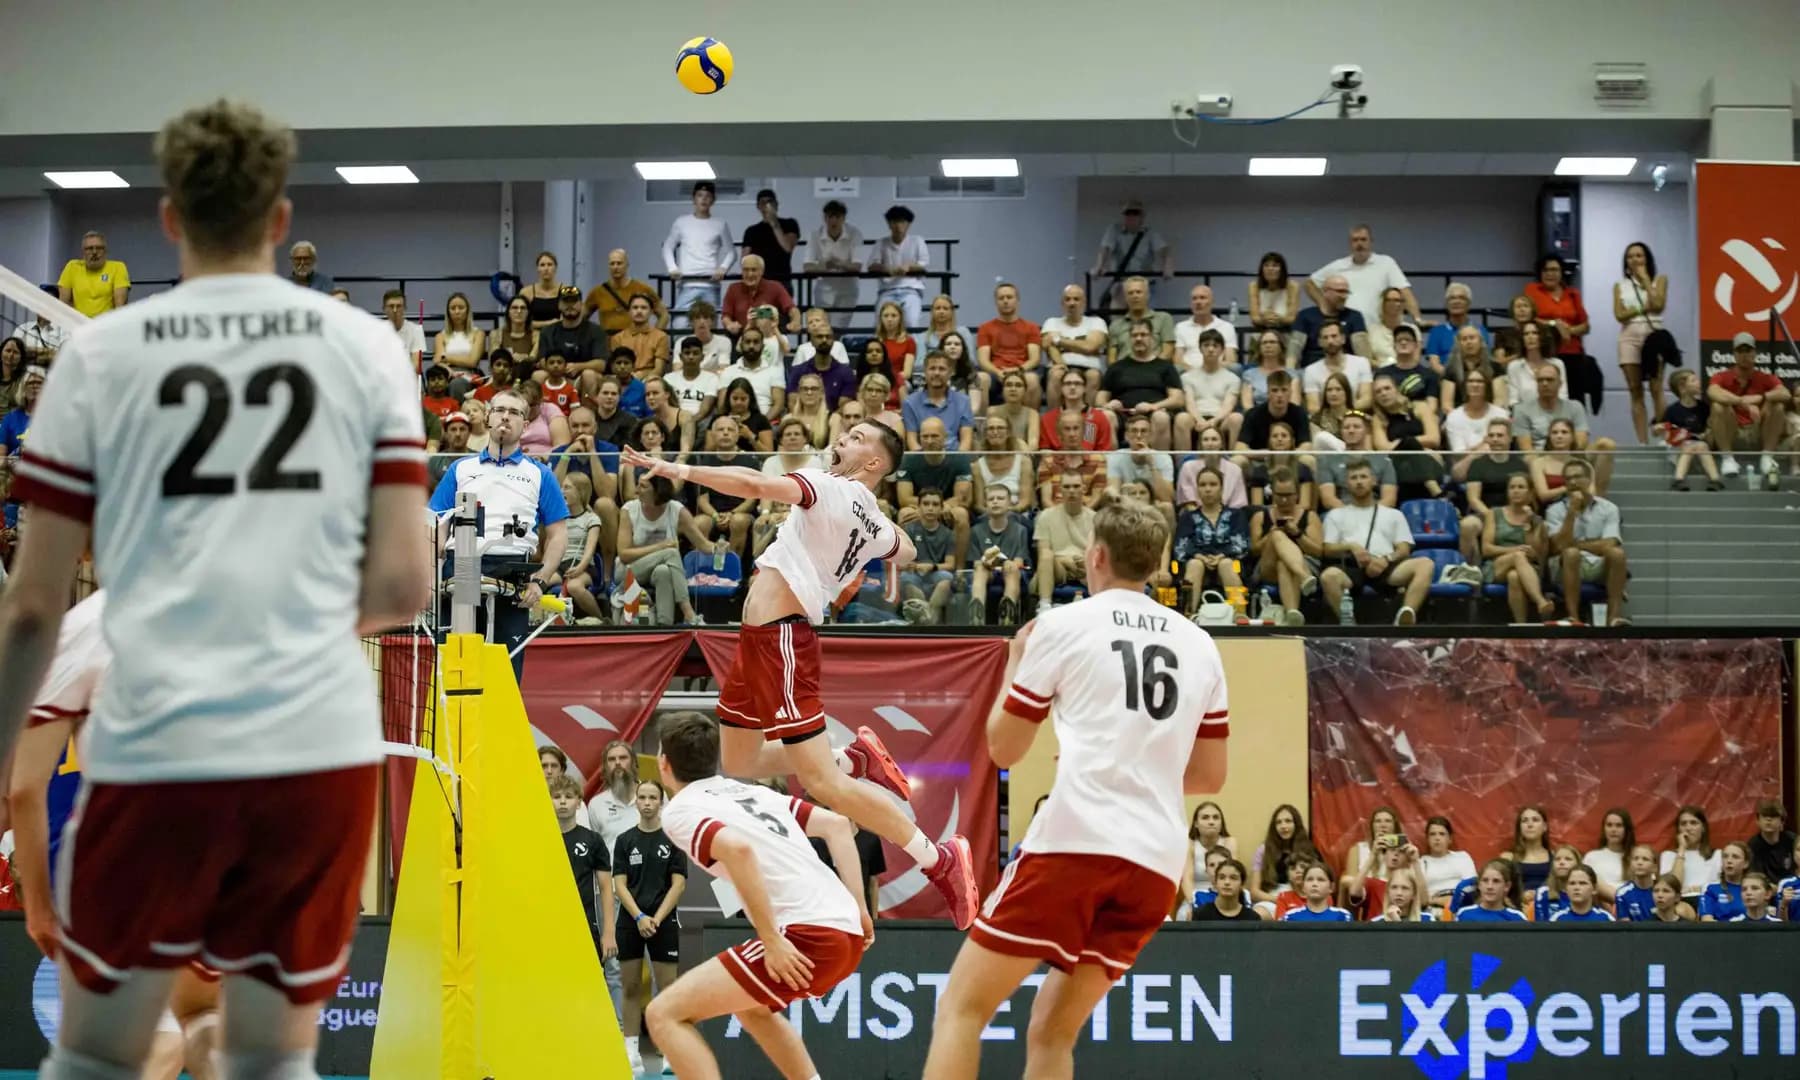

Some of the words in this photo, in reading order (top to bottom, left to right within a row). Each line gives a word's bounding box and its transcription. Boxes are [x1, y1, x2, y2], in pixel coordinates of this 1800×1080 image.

[159, 362, 321, 498] 22
[1112, 610, 1171, 633] GLATZ
[1111, 639, 1179, 721] 16
[734, 797, 789, 838] 5
[336, 975, 382, 998] Eur
[1339, 964, 1797, 1080] Experien
